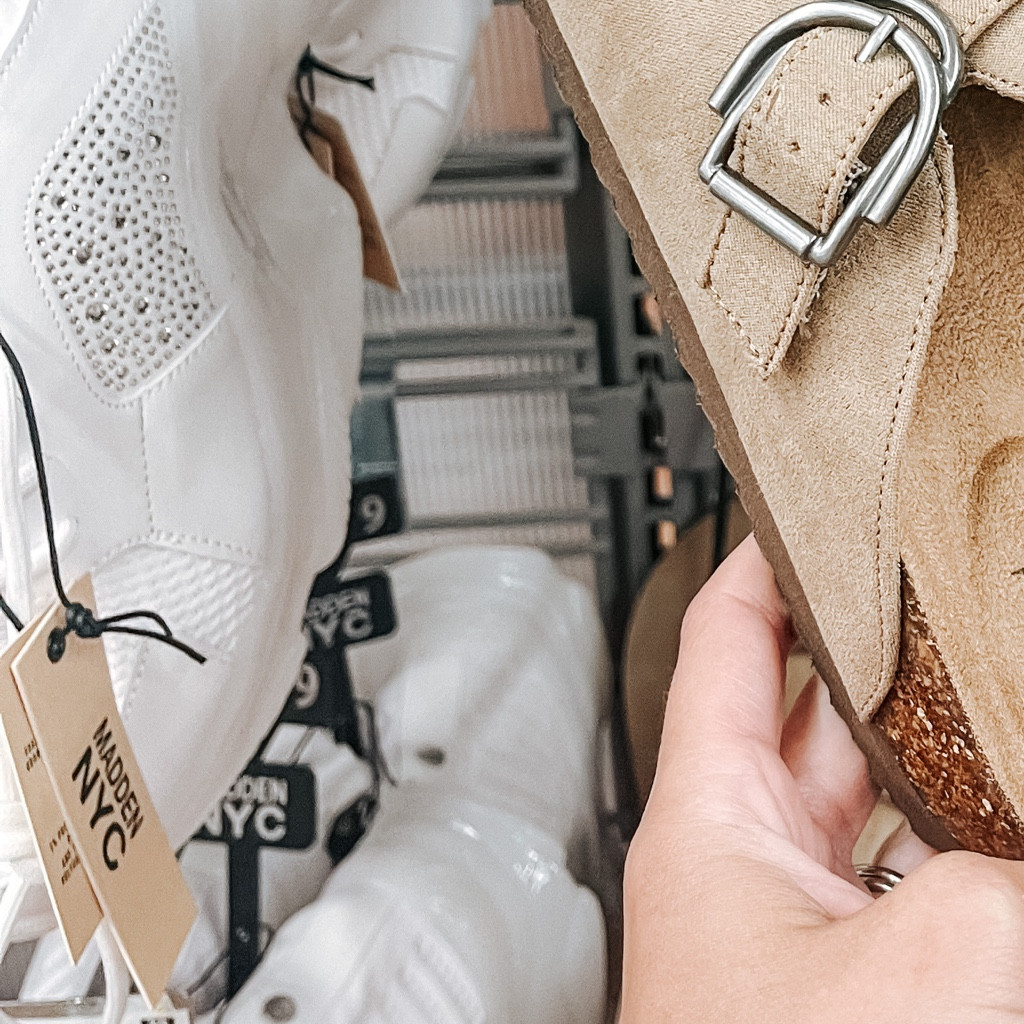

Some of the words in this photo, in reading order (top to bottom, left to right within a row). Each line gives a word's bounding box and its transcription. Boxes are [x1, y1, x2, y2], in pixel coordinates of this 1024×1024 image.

[358, 493, 388, 535] 9
[294, 662, 321, 710] 9
[71, 744, 127, 871] NYC
[92, 716, 144, 840] MADDEN
